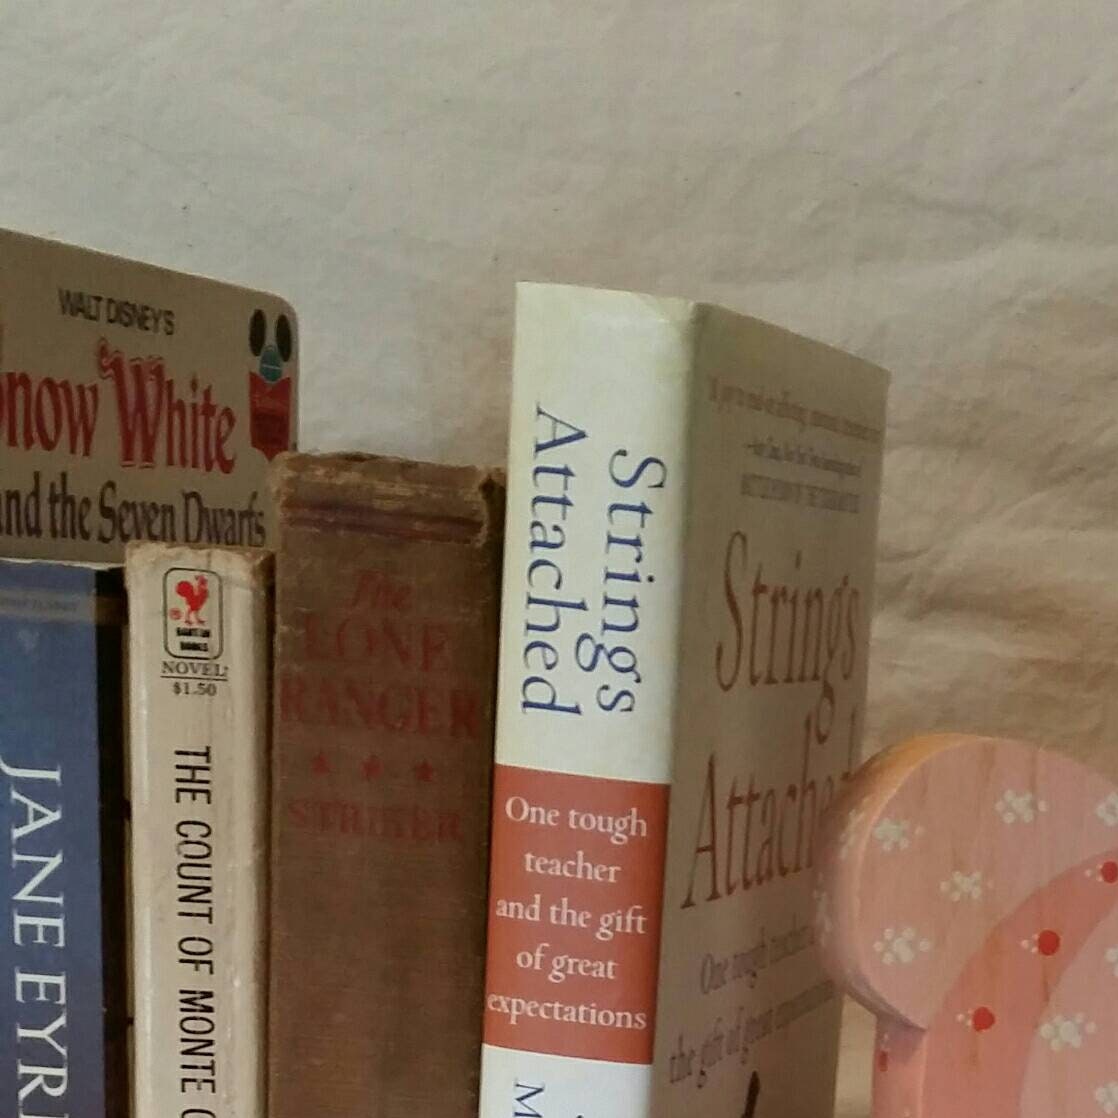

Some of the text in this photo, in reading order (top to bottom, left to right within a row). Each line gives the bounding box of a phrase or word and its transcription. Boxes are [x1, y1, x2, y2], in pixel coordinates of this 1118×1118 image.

[58, 288, 175, 336] WALT DISNEY'S
[0, 336, 236, 475] now White
[47, 471, 91, 541] the
[97, 480, 177, 544] Seven
[181, 489, 266, 548] Dwarfs
[520, 401, 589, 717] Attached
[575, 448, 667, 714] Strings
[715, 530, 860, 744] Strings
[173, 682, 217, 697] $1.50
[174, 745, 212, 805] THE
[505, 796, 648, 845] One tough
[0, 755, 65, 948] JANE
[175, 819, 213, 925] COUNT
[524, 850, 622, 884] teacher
[495, 893, 648, 942] and the gift
[178, 936, 215, 975] OF
[516, 942, 619, 983] of great
[487, 992, 648, 1030] expectations
[179, 989, 216, 1094] MONTE
